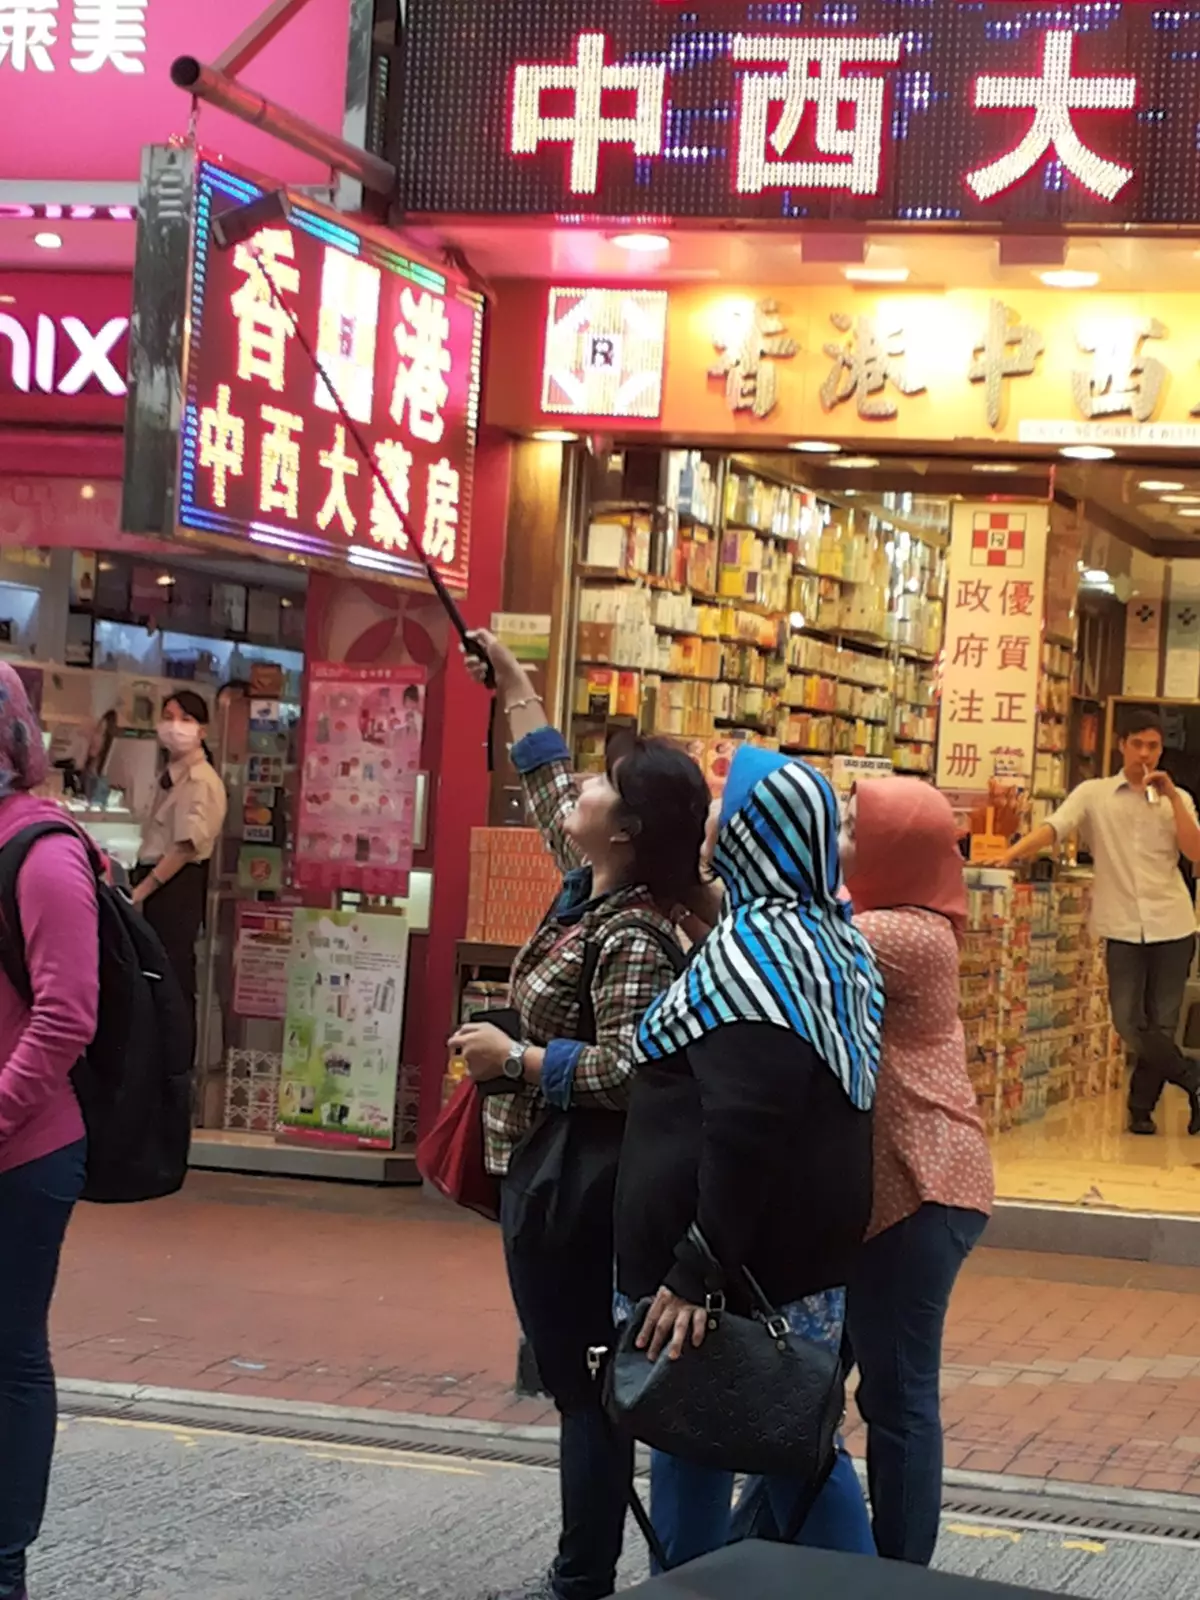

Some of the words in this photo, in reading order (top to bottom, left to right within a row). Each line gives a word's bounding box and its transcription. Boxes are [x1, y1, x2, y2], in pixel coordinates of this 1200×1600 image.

[511, 29, 1137, 201] 中西大
[706, 296, 1200, 429] 香港中西
